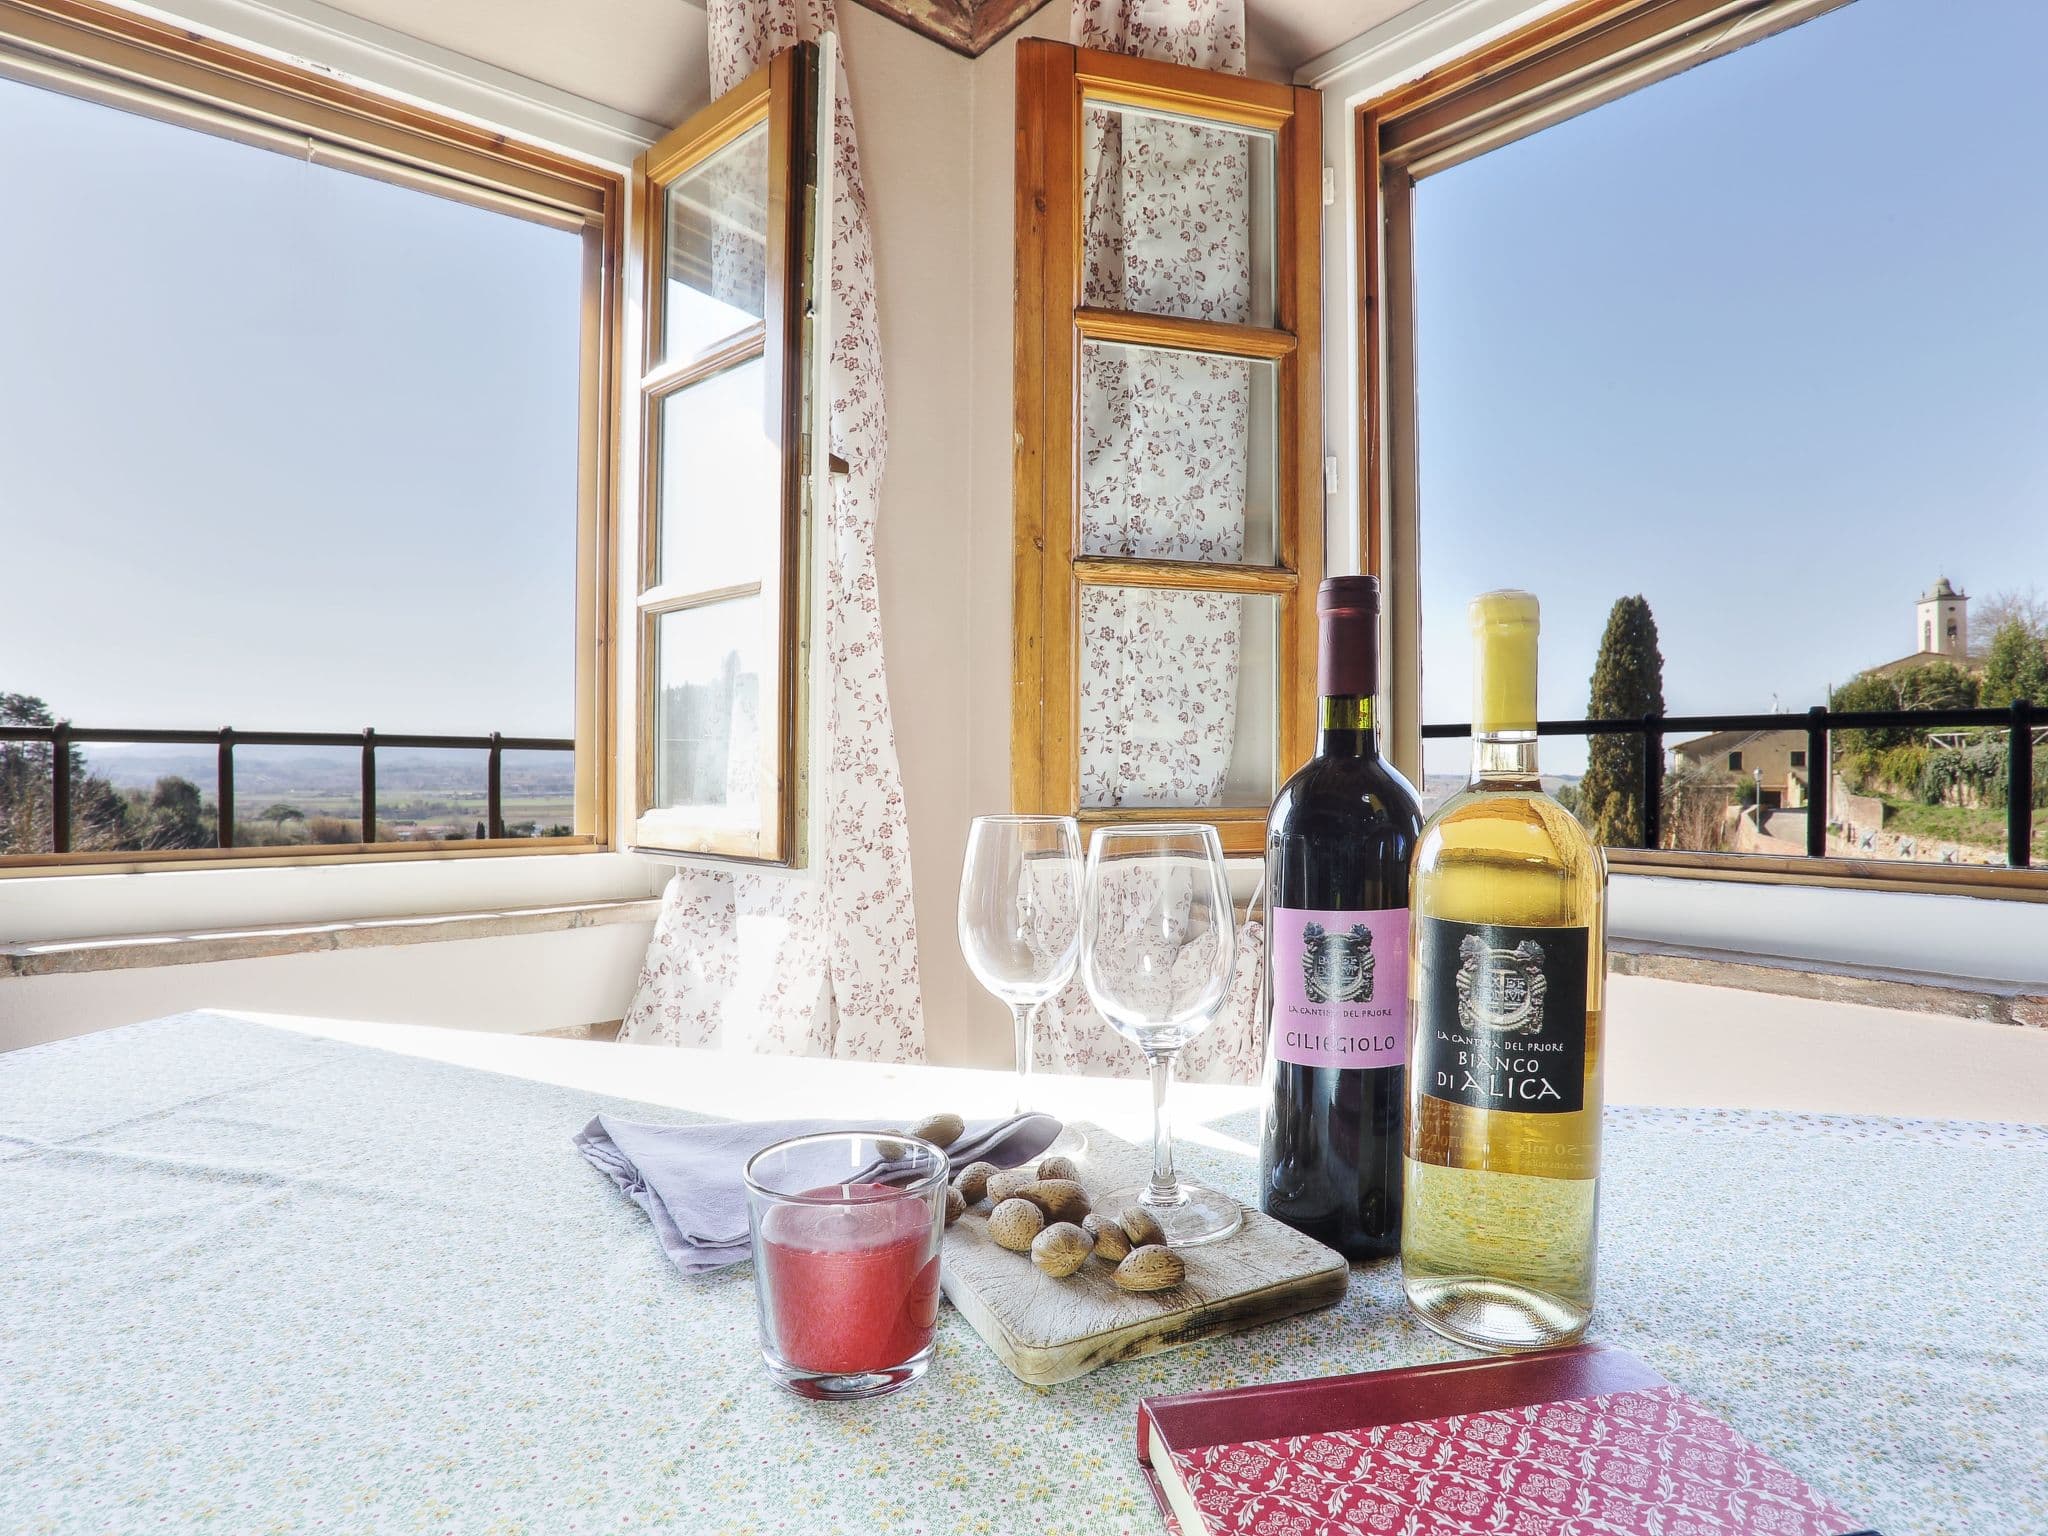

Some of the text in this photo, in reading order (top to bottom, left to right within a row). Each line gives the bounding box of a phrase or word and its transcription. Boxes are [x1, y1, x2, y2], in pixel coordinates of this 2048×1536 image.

[1289, 1005, 1393, 1018] LA CANTI DEL PRIORE
[1286, 1032, 1395, 1054] CILIEGIOLO
[1437, 1030, 1563, 1052] LA CANTINA DEL PRIORE
[1458, 1051, 1539, 1073] BIANCO
[1437, 1070, 1561, 1100] DI ALICA
